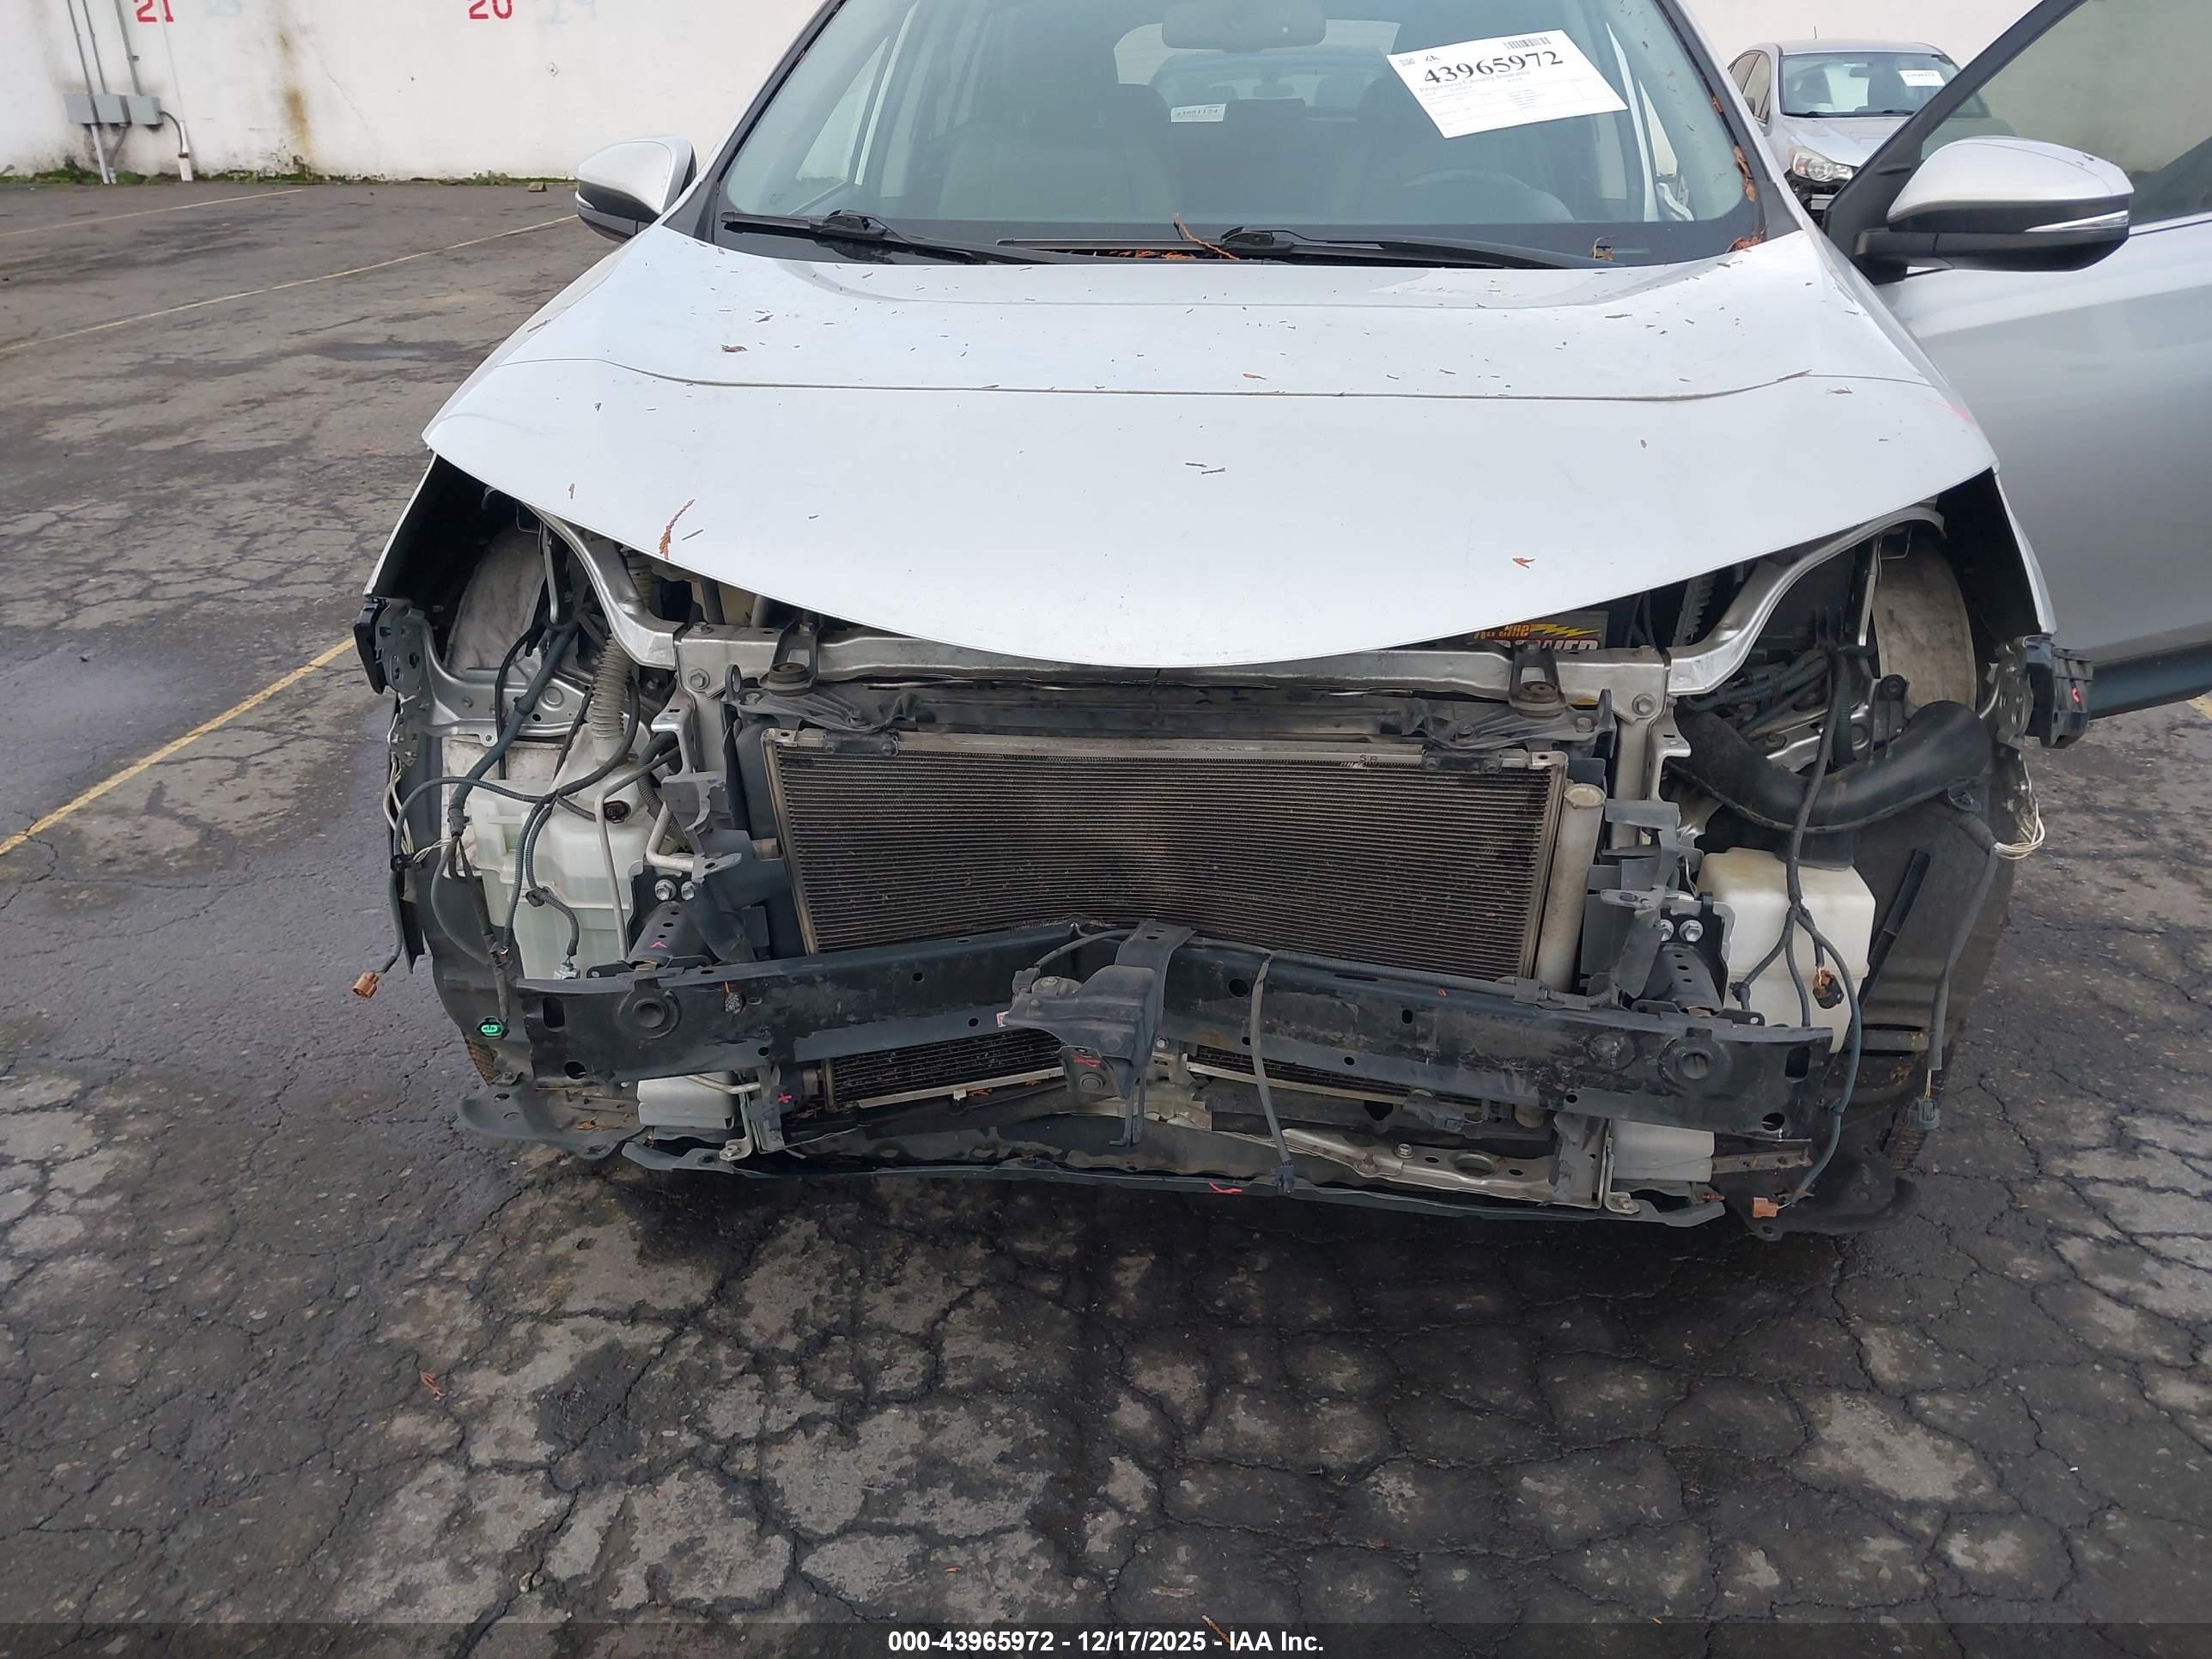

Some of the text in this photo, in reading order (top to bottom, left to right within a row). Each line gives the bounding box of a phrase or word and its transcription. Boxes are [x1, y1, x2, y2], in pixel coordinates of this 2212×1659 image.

[135, 0, 174, 22] 21
[468, 0, 514, 20] 20
[1424, 51, 1564, 83] 43965972
